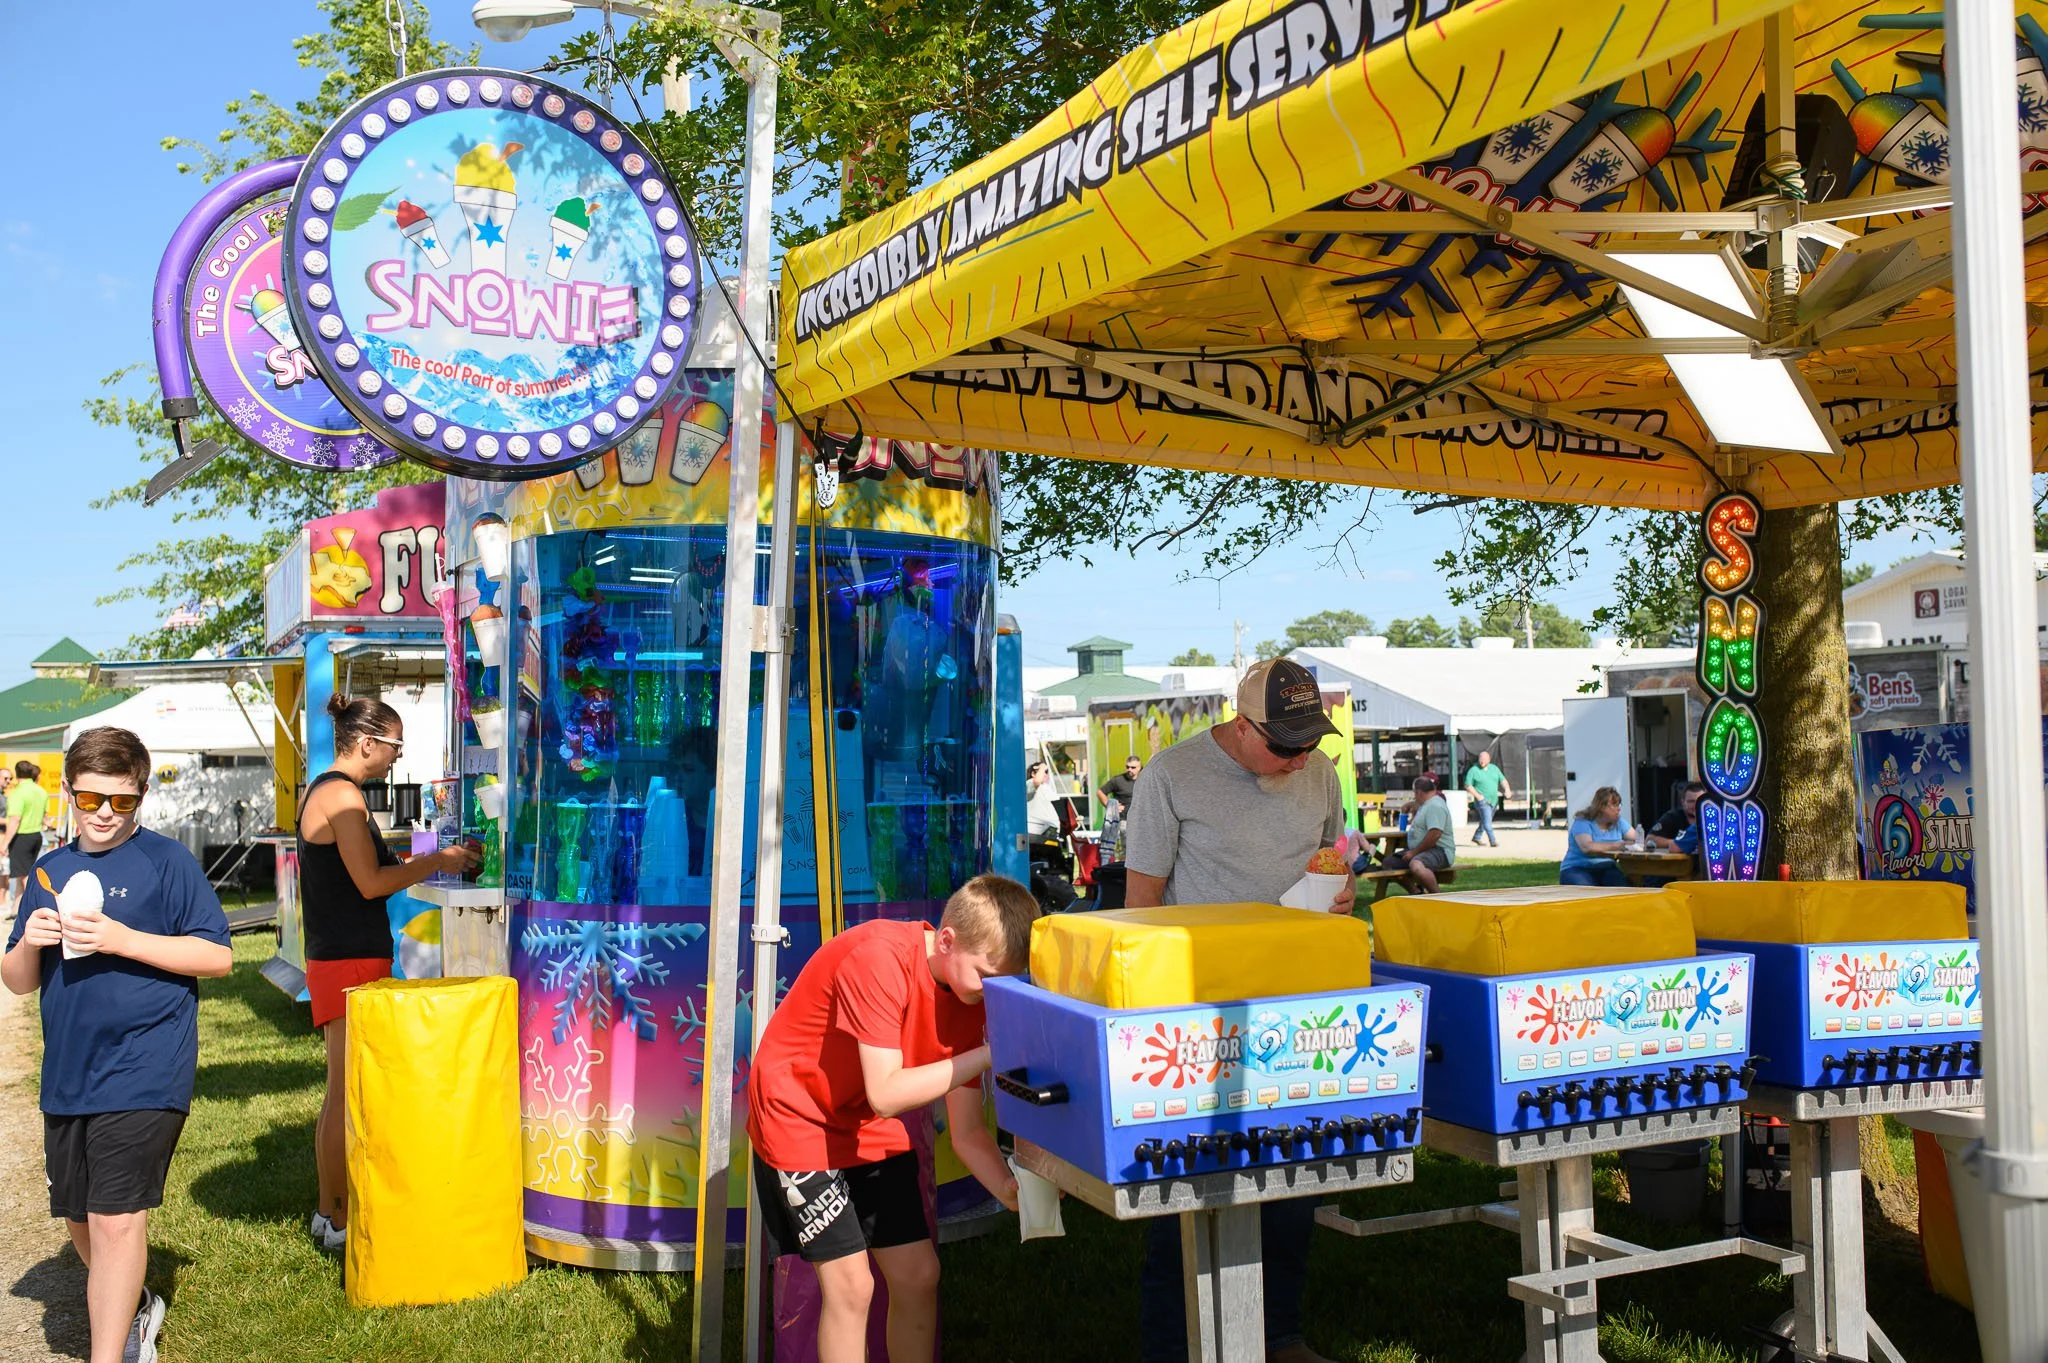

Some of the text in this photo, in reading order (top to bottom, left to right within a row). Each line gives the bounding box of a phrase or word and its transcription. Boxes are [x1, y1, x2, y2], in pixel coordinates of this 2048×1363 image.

[796, 206, 948, 341] INCREDIBLY
[946, 110, 1116, 262] AMAZING
[1119, 46, 1223, 172] SELF
[196, 224, 260, 337] The Cool
[367, 260, 641, 346] SNOWIE
[391, 349, 421, 369] The
[425, 359, 459, 379] cool
[462, 364, 493, 390] Part
[496, 381, 512, 395] of
[514, 374, 573, 397] summer
[1280, 364, 1388, 430] AND
[1944, 598, 1968, 610] SAVIN
[1700, 494, 1764, 880] SNOW
[1881, 800, 1911, 856] 6
[507, 873, 533, 890] CASH
[1881, 850, 1926, 878] Flavors
[1854, 965, 1977, 993] FLAVOR 9 STATION
[1552, 997, 1606, 1023] FLAVOR
[1617, 989, 1638, 1021] 9
[1646, 985, 1698, 1013] STATION
[1175, 1024, 1358, 1065] FLAVOR 9 STATION
